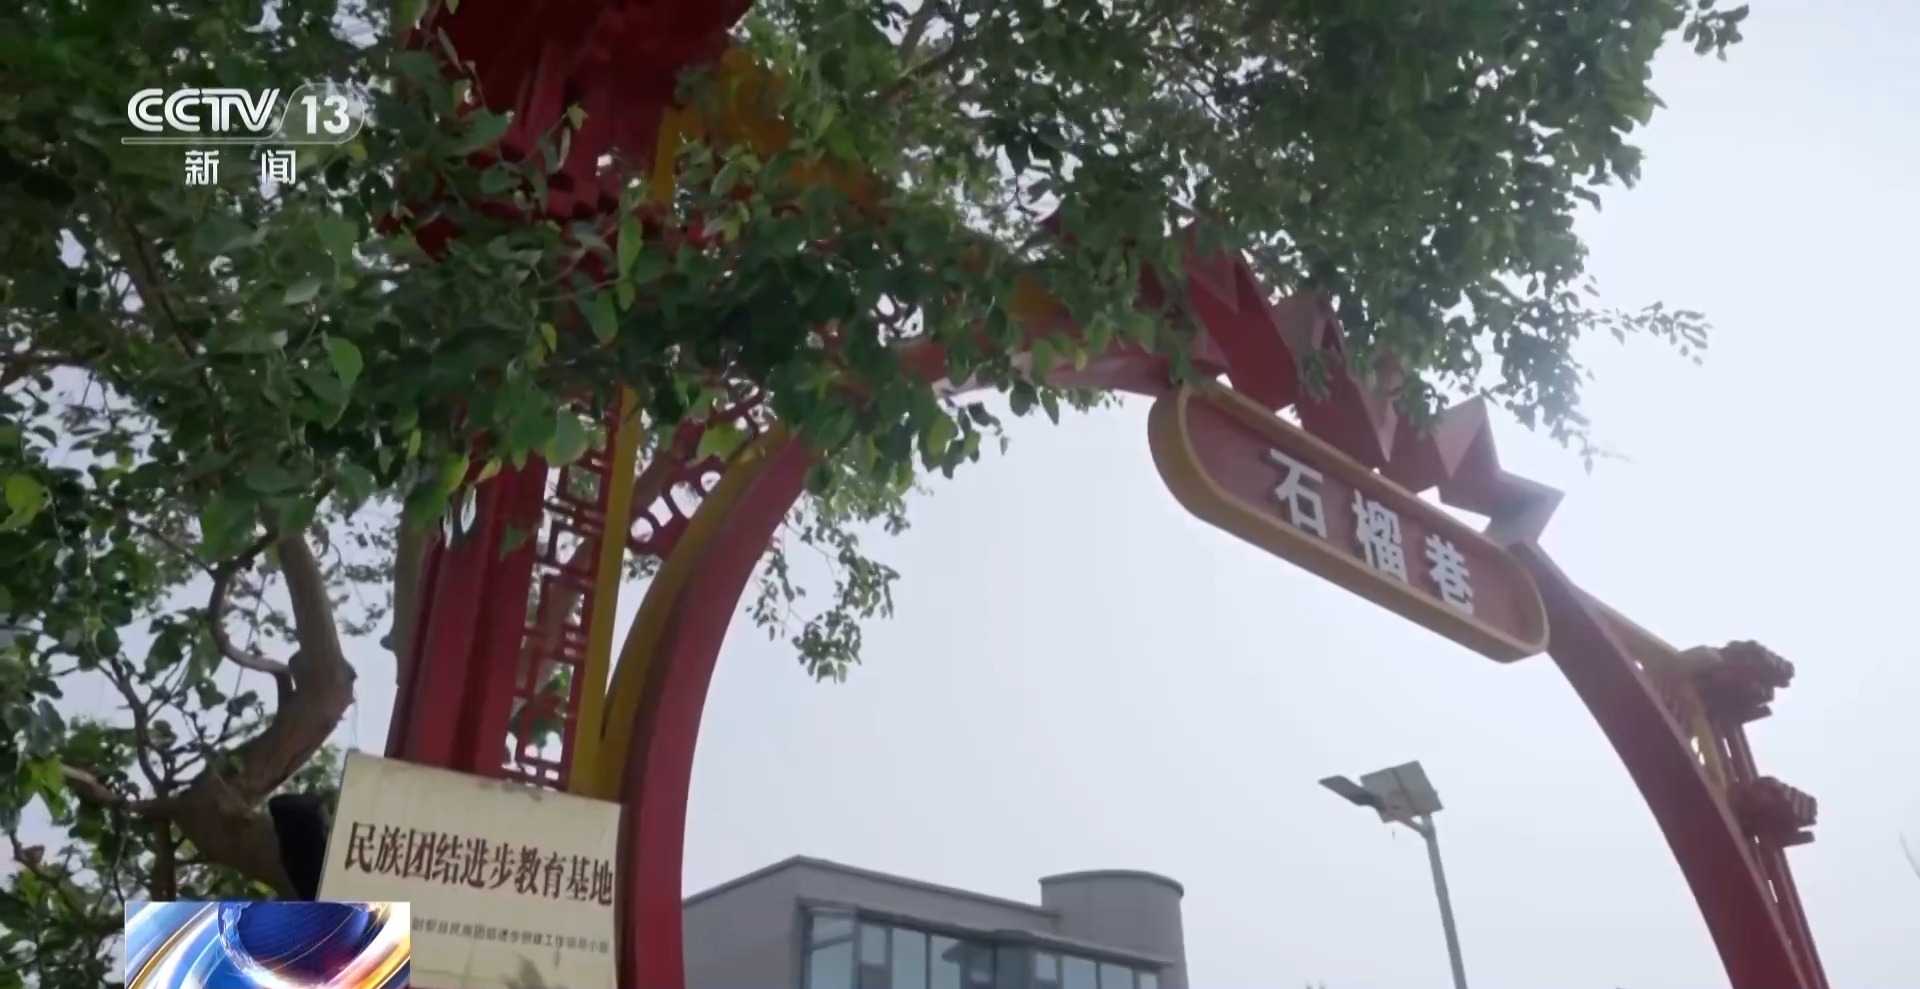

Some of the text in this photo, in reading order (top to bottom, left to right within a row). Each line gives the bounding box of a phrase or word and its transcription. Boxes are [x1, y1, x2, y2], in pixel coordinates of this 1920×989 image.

[1269, 449, 1474, 614] 石榴巷
[344, 822, 613, 906] 民族团结进步教育基地
